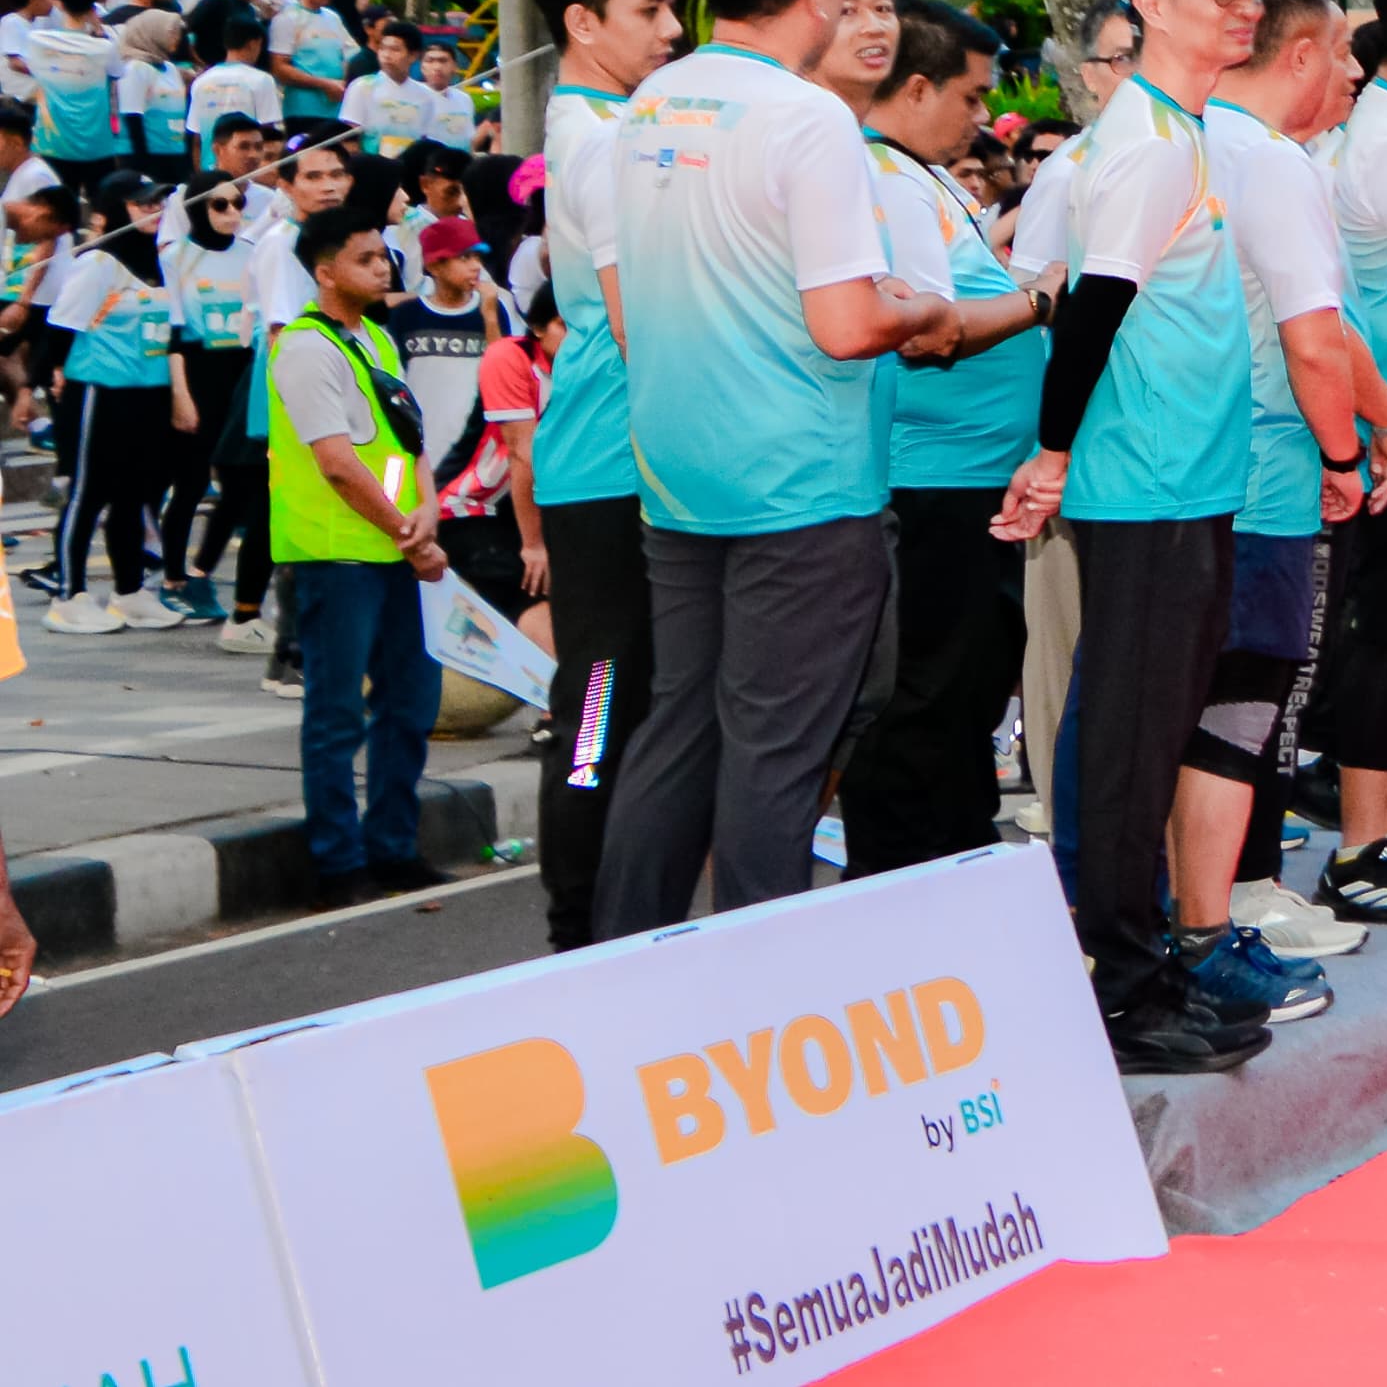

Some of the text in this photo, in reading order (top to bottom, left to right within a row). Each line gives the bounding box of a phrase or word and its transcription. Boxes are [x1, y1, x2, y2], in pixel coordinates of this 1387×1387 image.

[635, 976, 985, 1167] BYOND
[921, 1113, 955, 1152] by
[724, 1191, 1044, 1375] #SemuaJadiMudah
